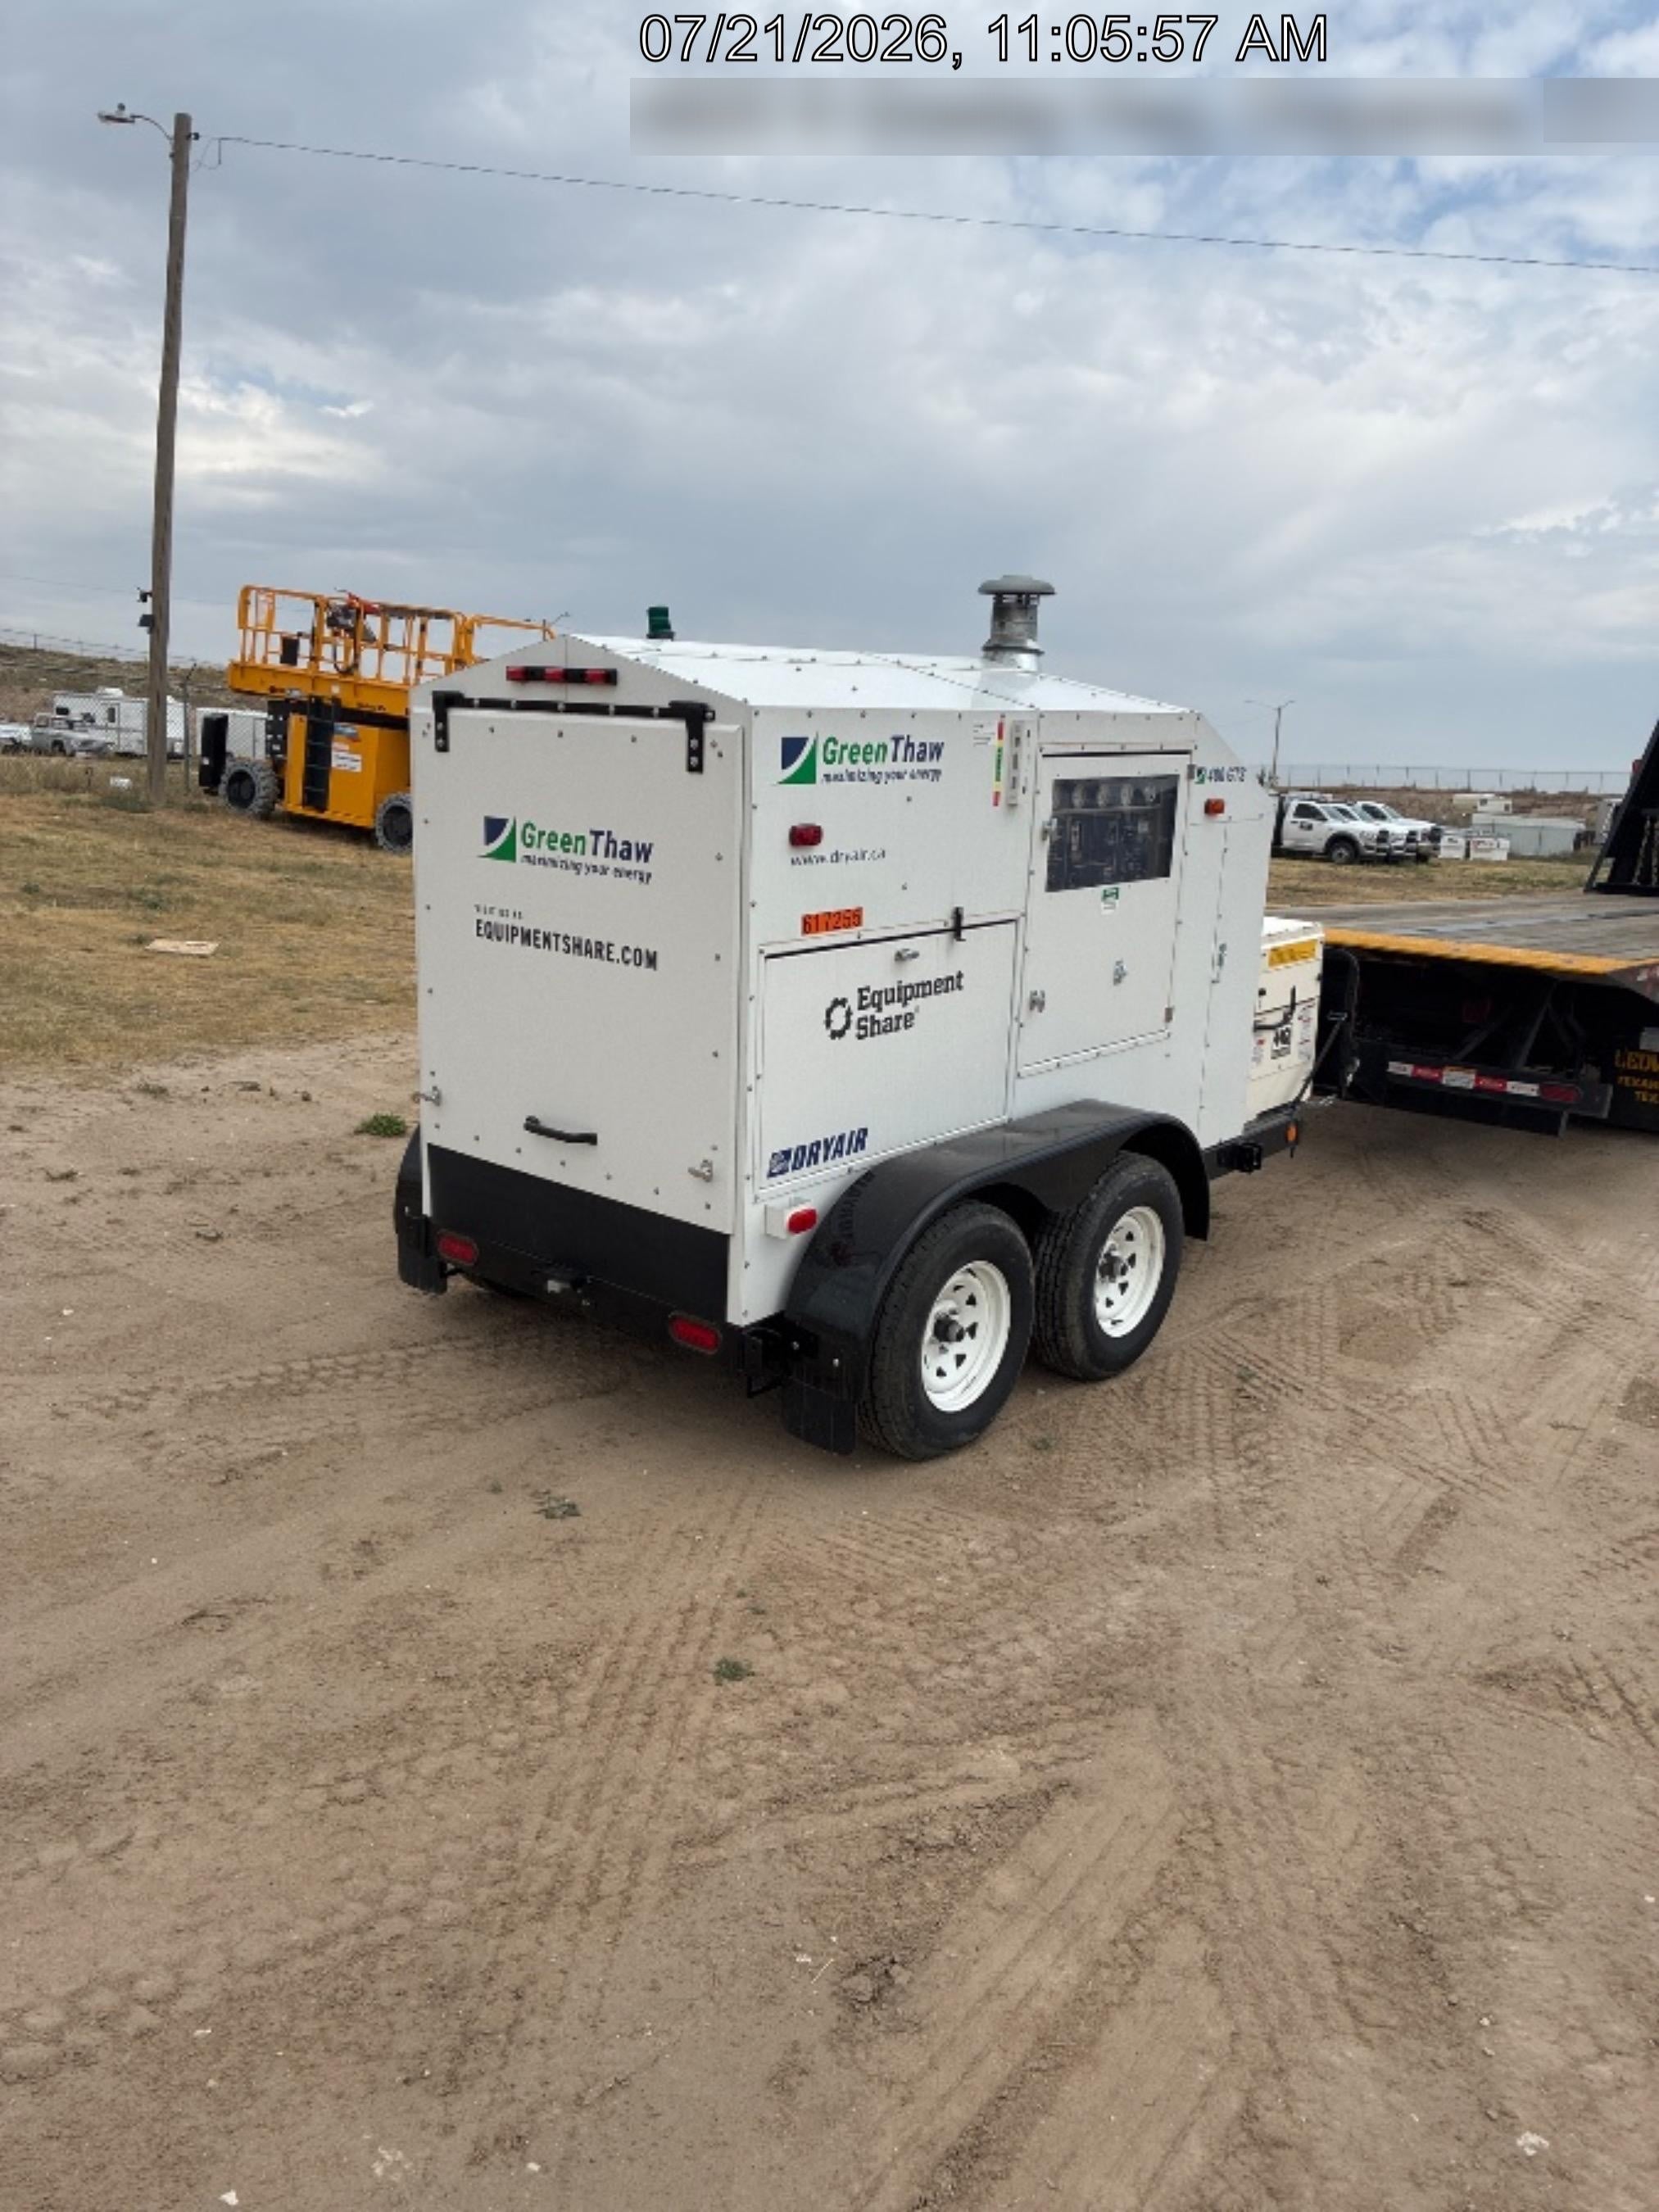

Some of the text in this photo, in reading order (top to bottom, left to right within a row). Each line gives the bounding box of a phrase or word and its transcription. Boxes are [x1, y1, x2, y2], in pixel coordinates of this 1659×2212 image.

[476, 918, 658, 971] EQUIPMENTSHARE.COM
[857, 970, 964, 1013] Equipment
[791, 1127, 868, 1172] DRYAIR
